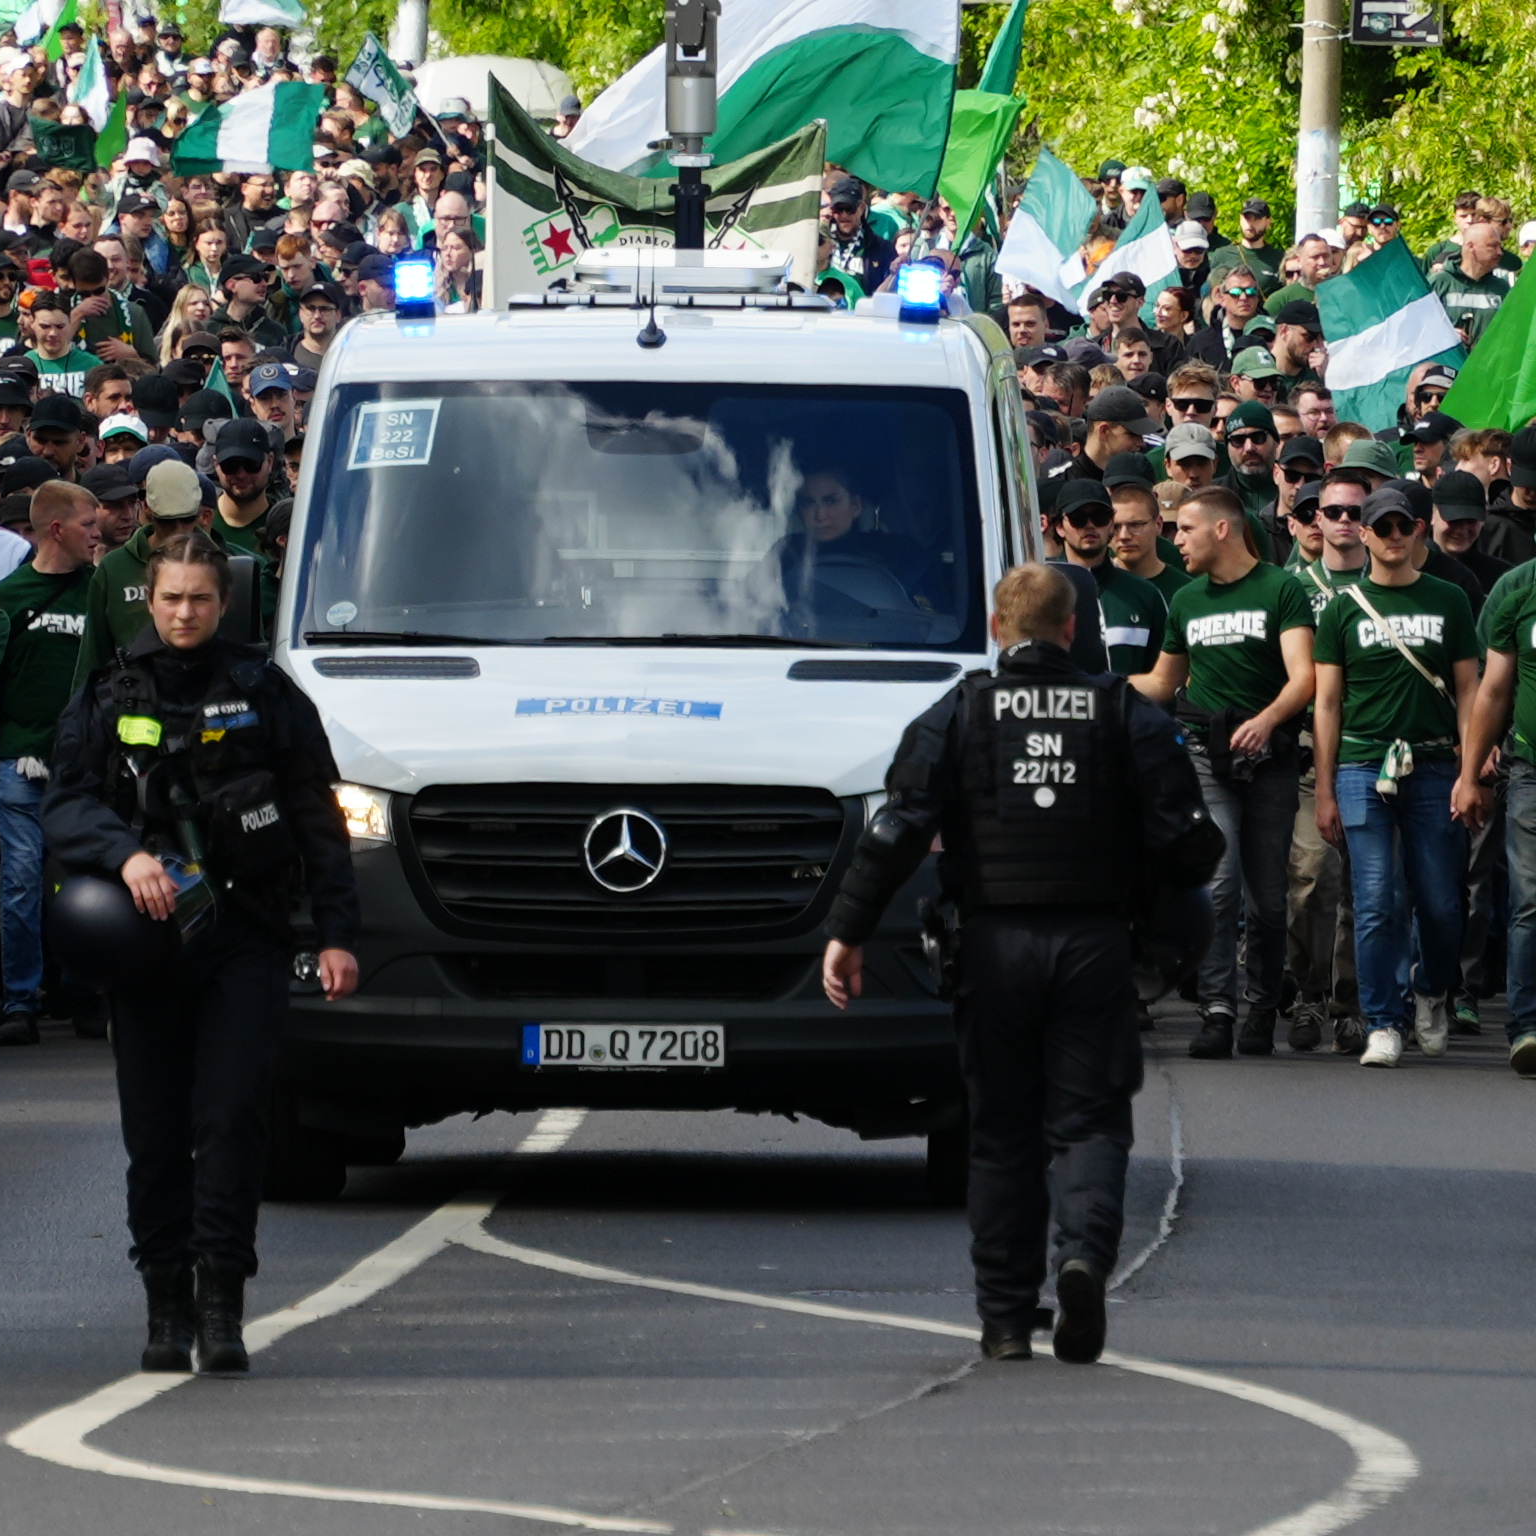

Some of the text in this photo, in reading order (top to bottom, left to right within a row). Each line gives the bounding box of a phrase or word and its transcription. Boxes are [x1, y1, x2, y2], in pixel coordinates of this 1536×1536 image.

[619, 236, 675, 249] DIABLO
[386, 412, 414, 426] SN
[379, 430, 414, 443] 222
[1186, 609, 1268, 647] CHEMIE
[544, 698, 692, 715] POLIZEI
[994, 689, 1095, 721] POLIZEI
[1026, 732, 1062, 757] SN
[1013, 761, 1076, 784] 22/12
[543, 1030, 719, 1062] DD Q 7208
